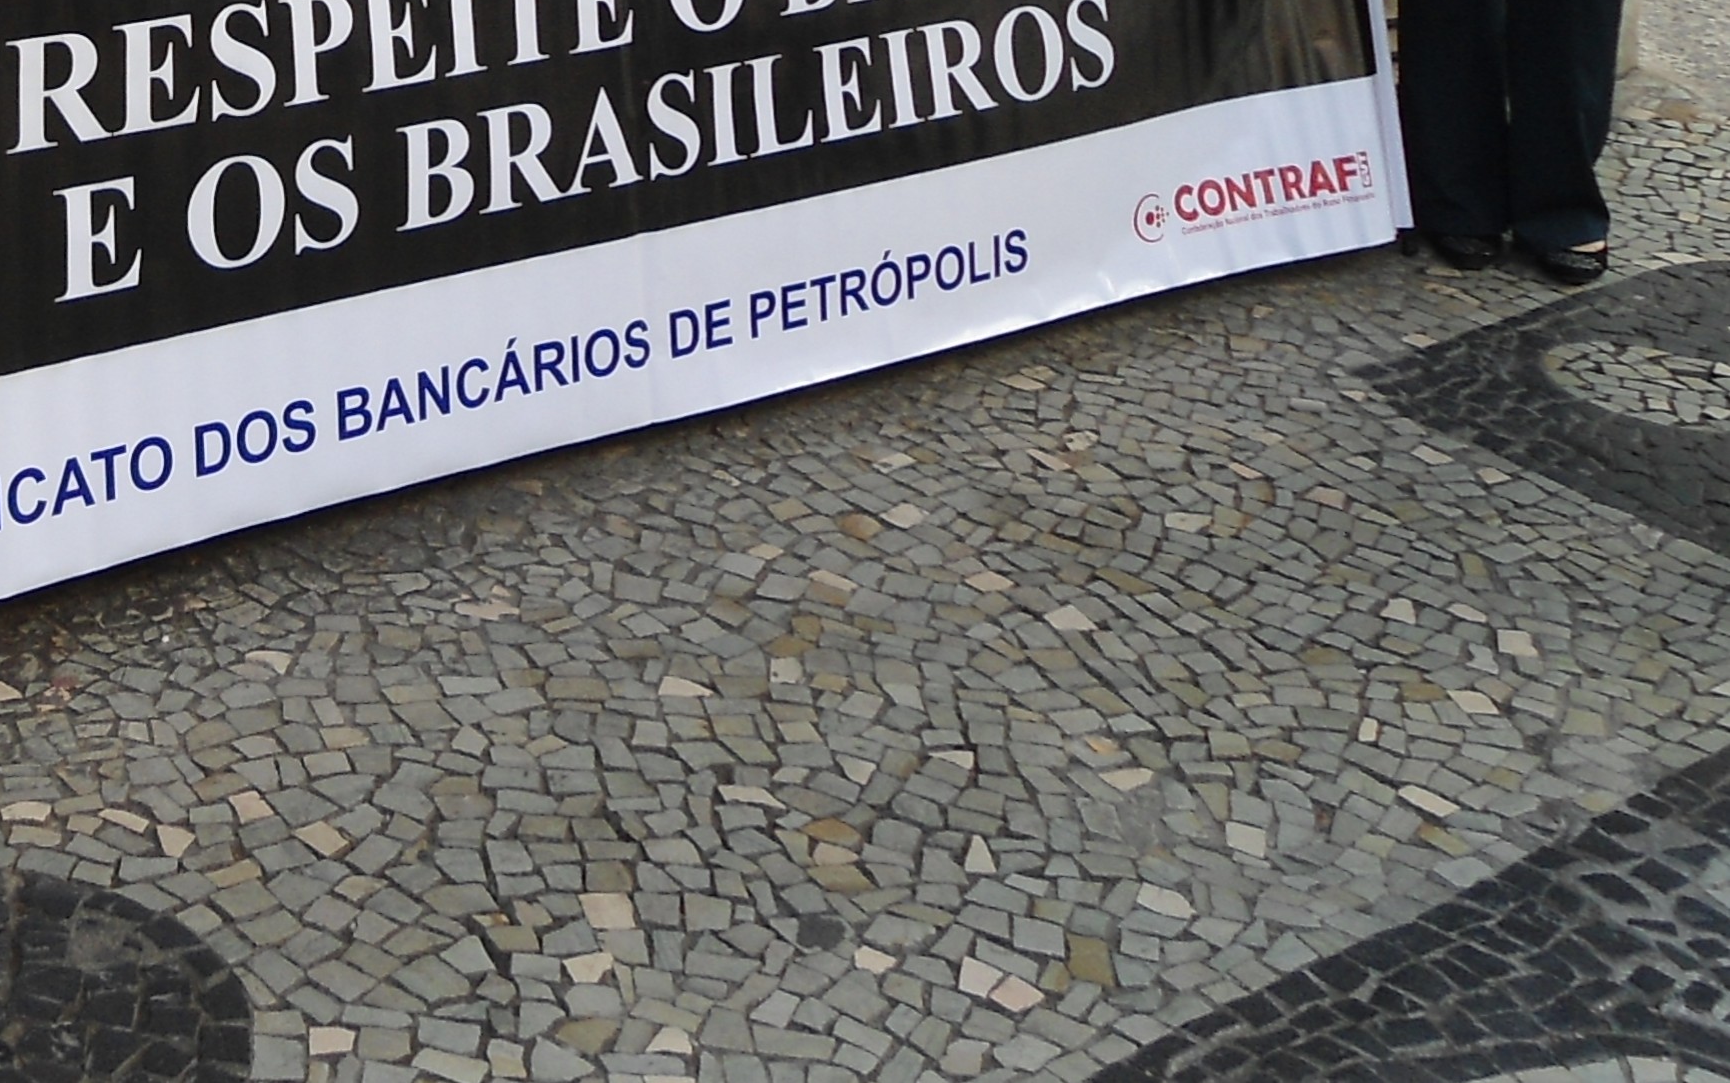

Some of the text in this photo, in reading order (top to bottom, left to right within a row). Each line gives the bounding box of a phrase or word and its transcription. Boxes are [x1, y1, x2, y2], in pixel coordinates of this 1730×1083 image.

[53, 176, 143, 304] E
[186, 134, 360, 271] OS
[1174, 155, 1358, 222] CONTRAF
[194, 398, 317, 478] DOS
[336, 318, 651, 442] BANCÁRIOS
[669, 298, 734, 359] DE
[749, 228, 1030, 341] PETRÓPOLIS
